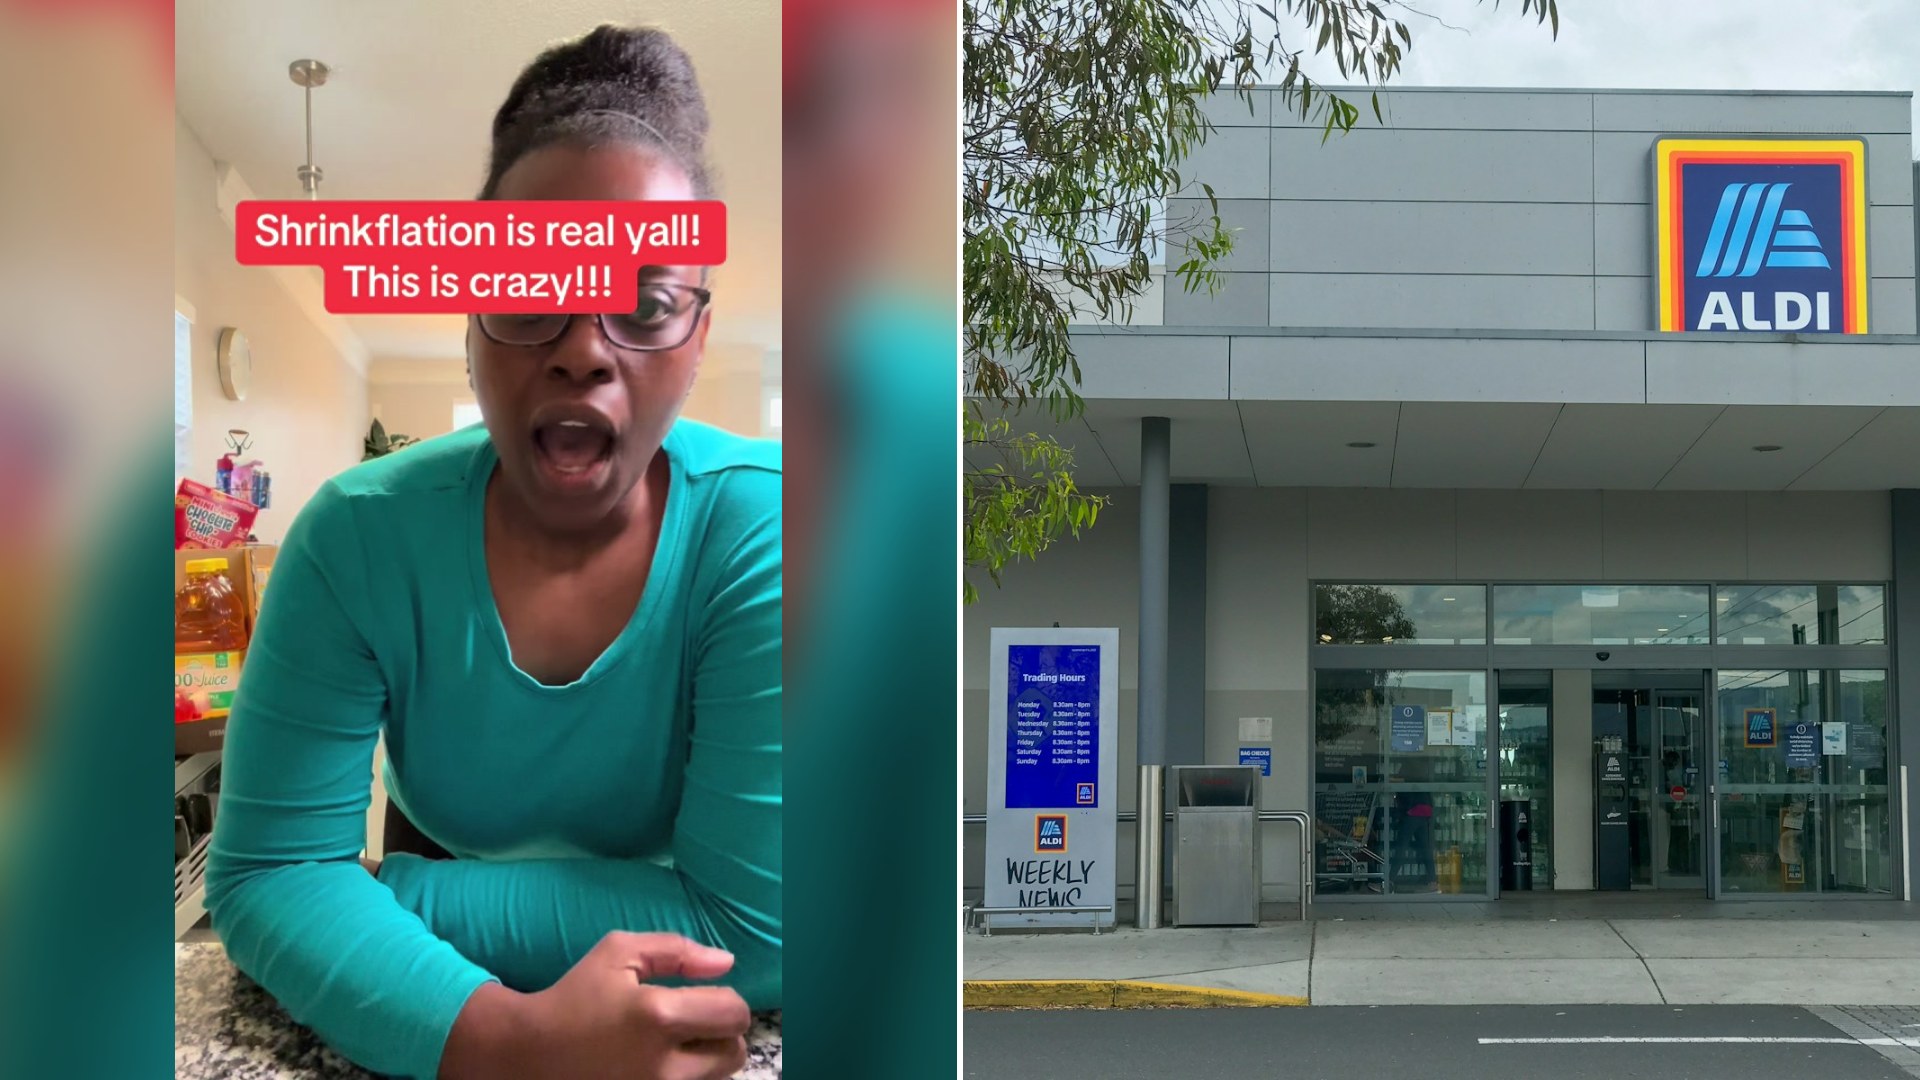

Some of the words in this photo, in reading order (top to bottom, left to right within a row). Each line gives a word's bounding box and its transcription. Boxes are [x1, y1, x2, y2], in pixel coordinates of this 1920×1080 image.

[1697, 291, 1830, 331] ALDI
[192, 497, 215, 511] MINI
[186, 529, 223, 546] COOKIES
[197, 671, 228, 687] Juice
[1023, 673, 1057, 684] Trading
[1059, 673, 1086, 682] Hours
[1750, 732, 1772, 740] ALDI
[1040, 837, 1063, 845] ALDI
[1006, 857, 1096, 885] WEEKLY
[1018, 887, 1082, 915] NEWS
